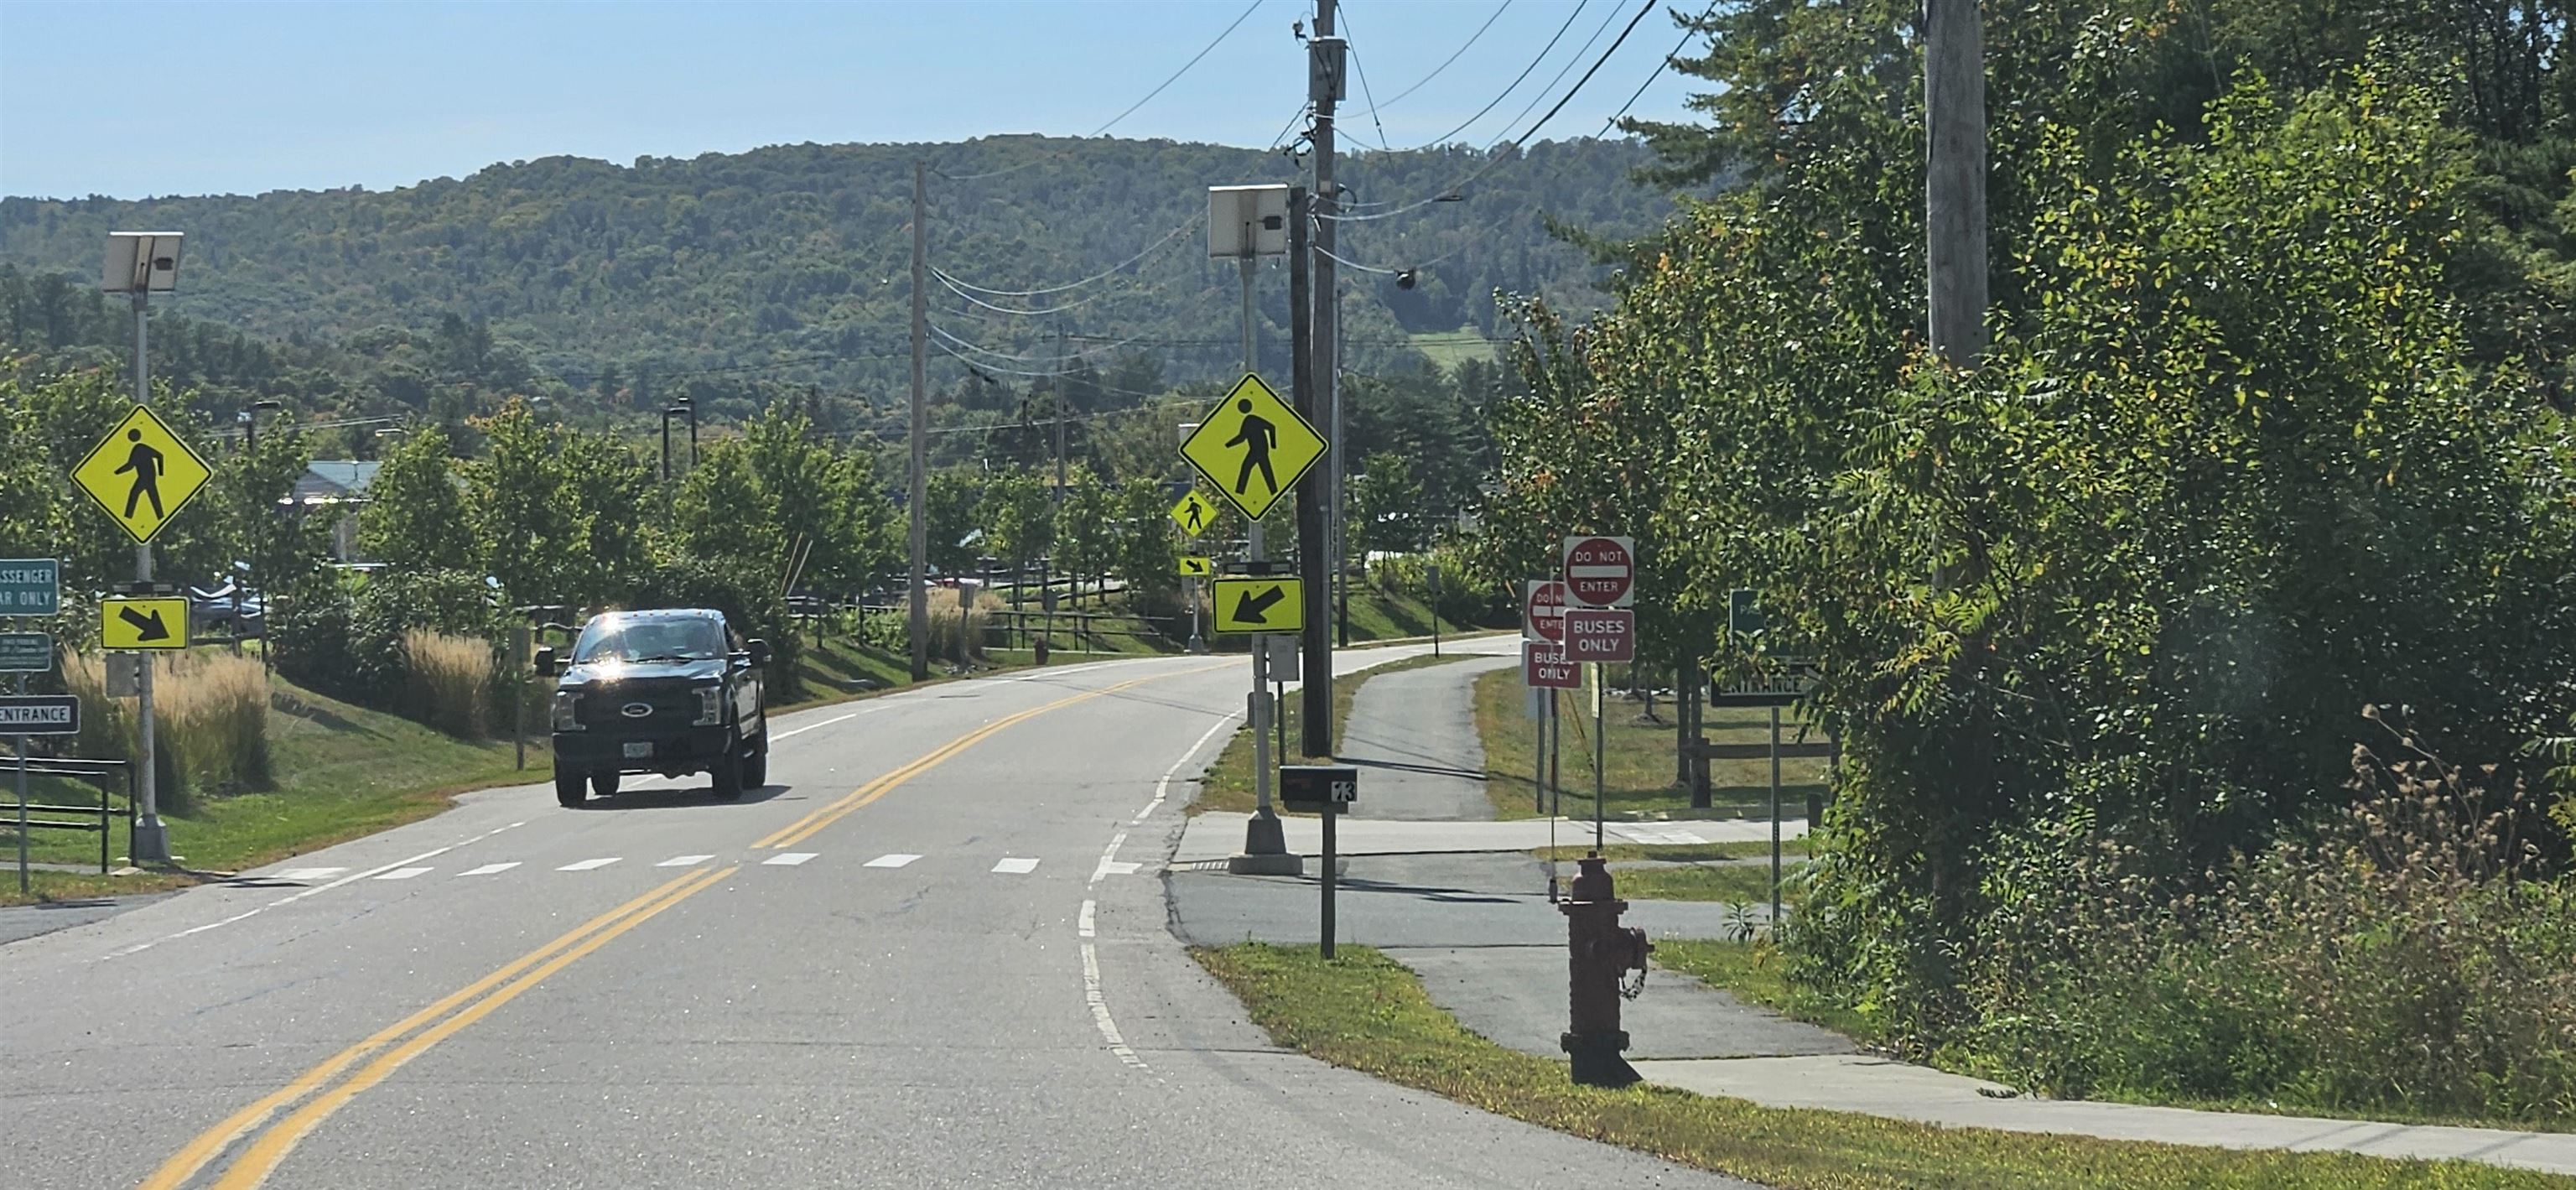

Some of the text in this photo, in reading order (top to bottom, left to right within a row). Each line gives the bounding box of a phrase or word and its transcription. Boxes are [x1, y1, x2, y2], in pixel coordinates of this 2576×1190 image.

[1575, 551, 1622, 563] DO NOT
[0, 569, 52, 584] SSENGER
[1580, 581, 1618, 592] ENTER
[19, 591, 50, 605] ONLY
[1536, 594, 1550, 603] DO
[1540, 619, 1564, 629] ENTE
[1573, 620, 1625, 634] BUSES
[1579, 639, 1620, 652] ONLY
[1535, 652, 1573, 665] BUSE
[1538, 668, 1571, 679] ONLY
